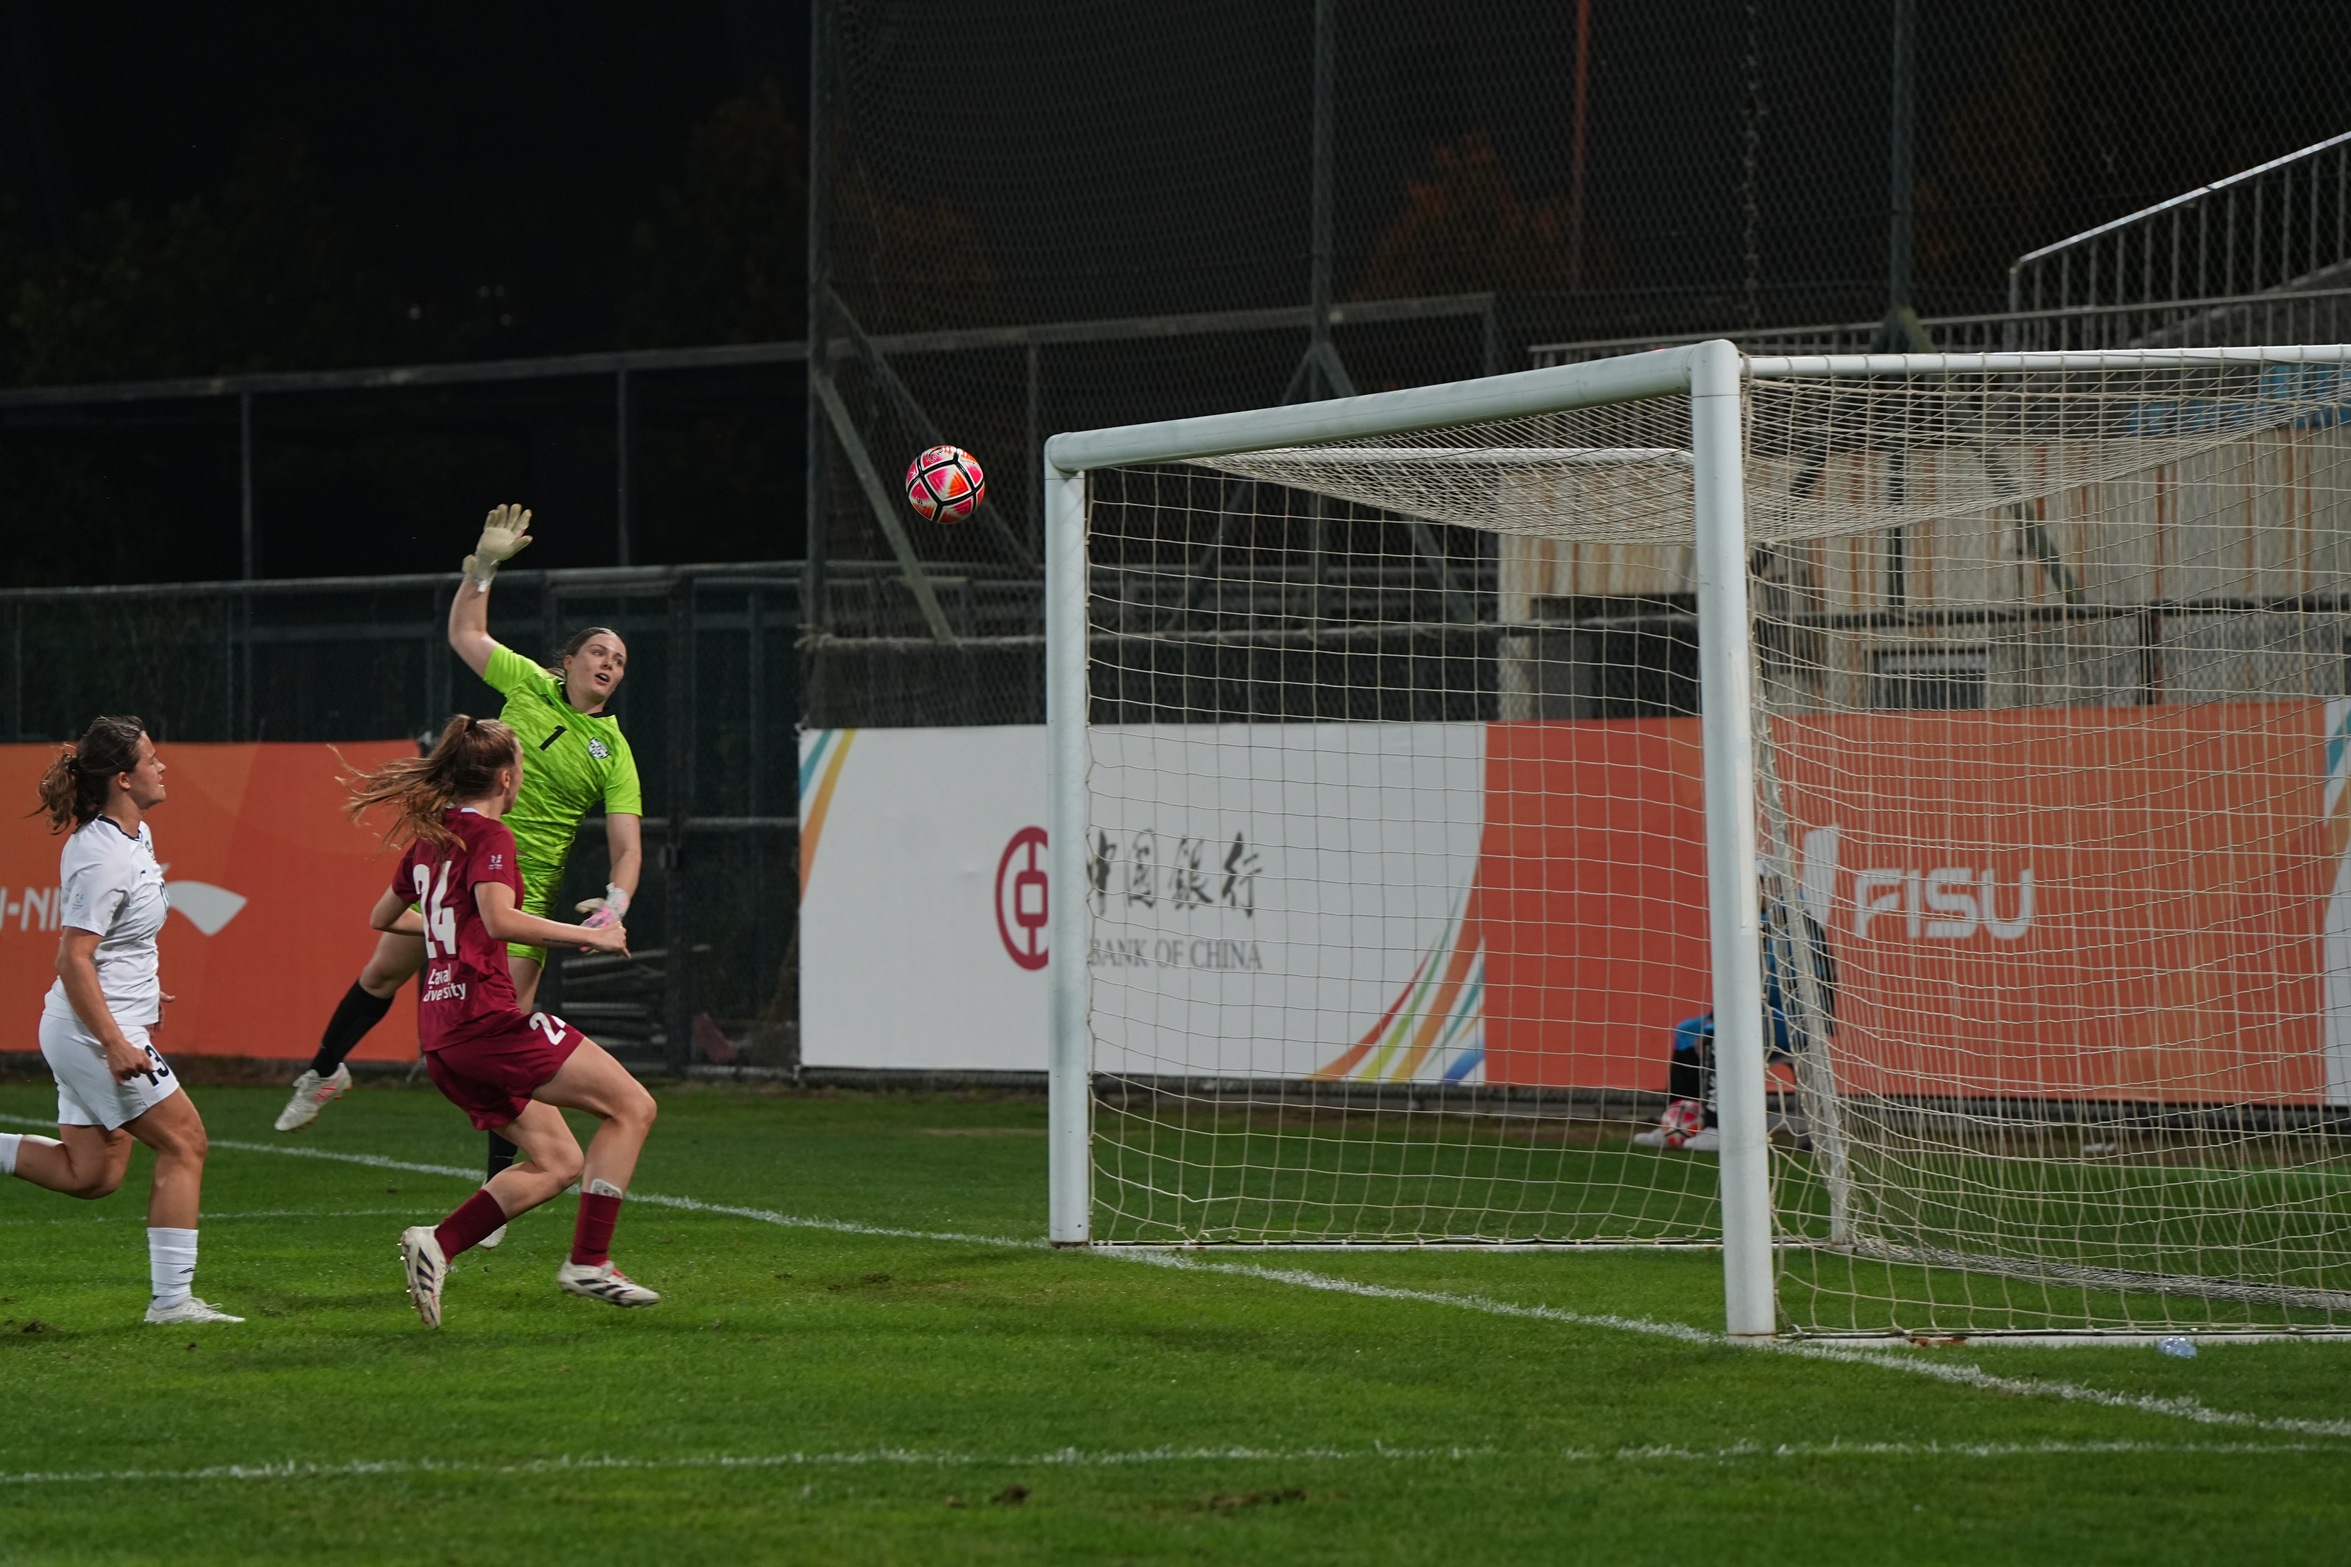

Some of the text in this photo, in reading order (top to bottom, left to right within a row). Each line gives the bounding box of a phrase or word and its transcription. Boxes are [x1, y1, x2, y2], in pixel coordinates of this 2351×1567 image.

[539, 725, 567, 751] 1
[413, 861, 457, 959] 24
[1855, 867, 2034, 940] FISU
[1089, 937, 1263, 970] BANK OF CHINA
[529, 1011, 566, 1045] 2
